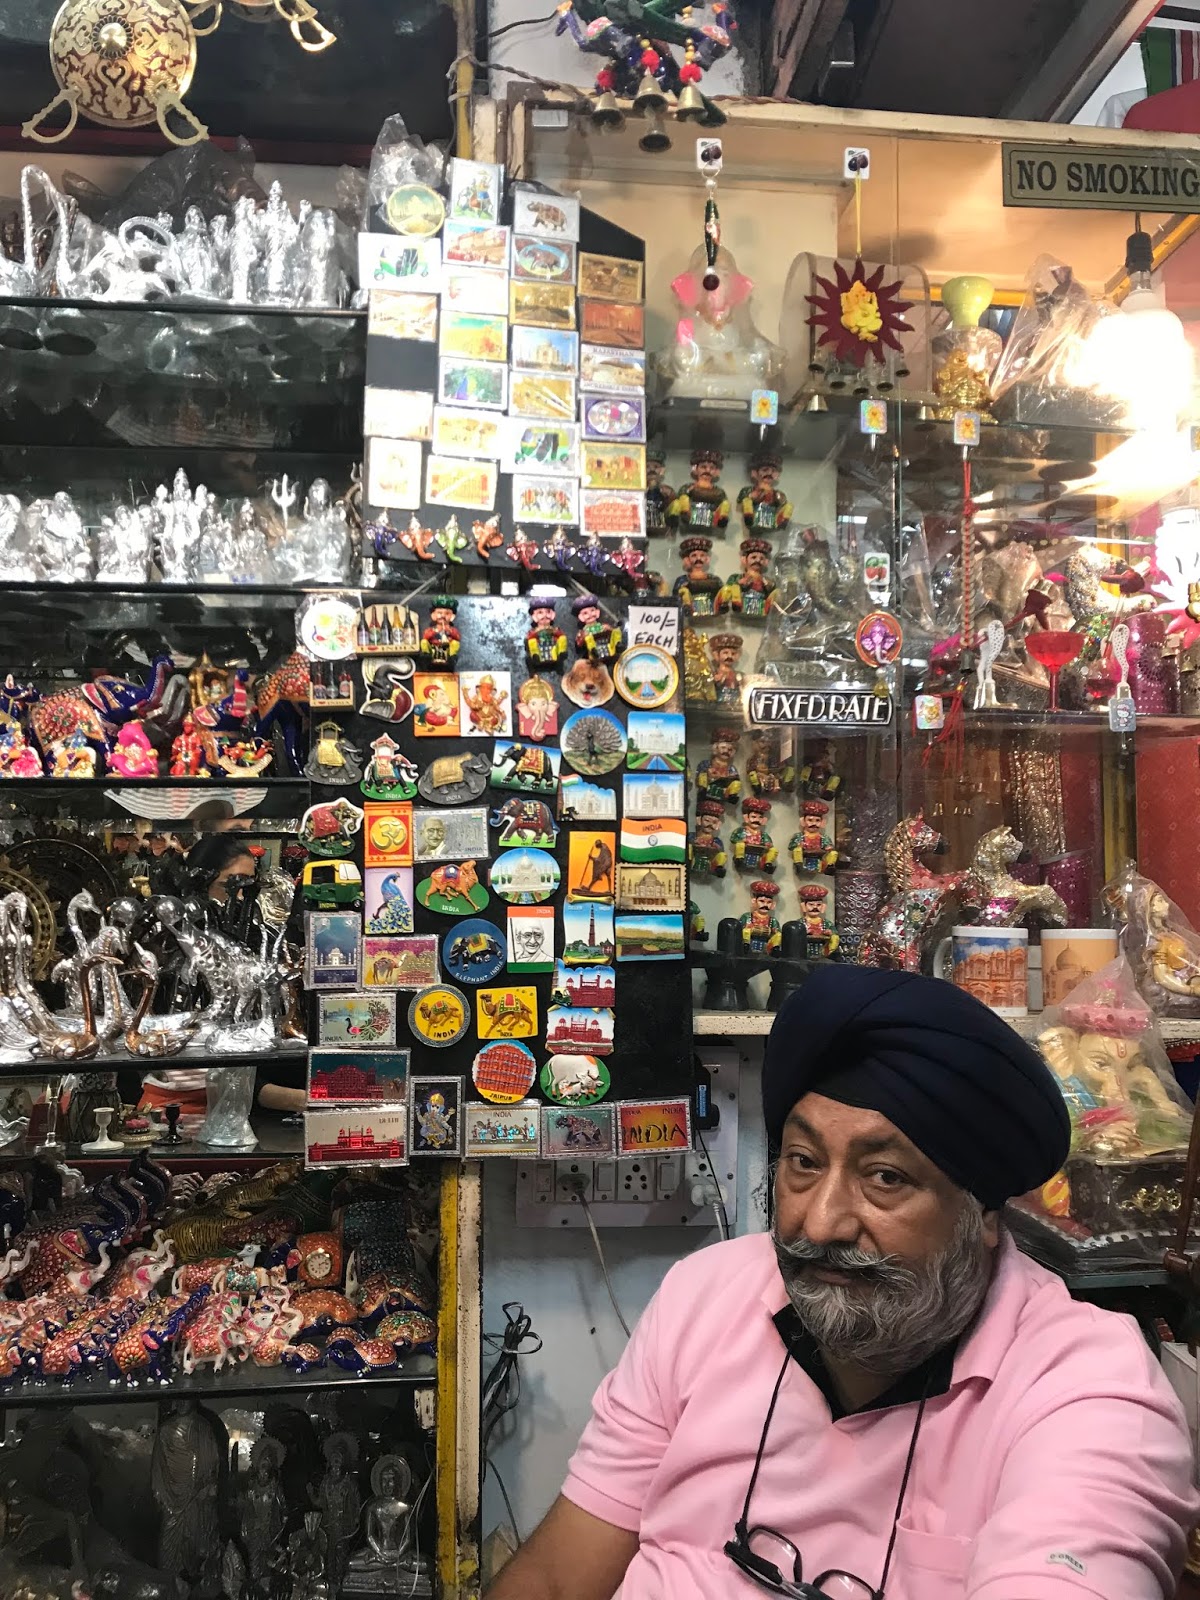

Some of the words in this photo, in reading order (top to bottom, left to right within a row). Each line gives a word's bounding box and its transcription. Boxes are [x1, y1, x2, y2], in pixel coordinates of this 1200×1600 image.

[1017, 159, 1057, 191] NO
[1066, 161, 1200, 198] SMOKING
[634, 631, 674, 648] EACH
[757, 693, 826, 721] FIXED
[828, 694, 888, 721] RATE
[445, 794, 462, 802] INDIA
[642, 823, 663, 832] INDIA
[632, 898, 668, 906] INDIA
[441, 904, 460, 913] INDIA
[455, 972, 489, 982] ELEPHANT
[490, 961, 504, 976] INDIA
[433, 1028, 456, 1038] INDIA
[489, 1092, 513, 1102] JAIPUR
[662, 1107, 685, 1115] INDIA
[622, 1123, 688, 1144] INDIA
